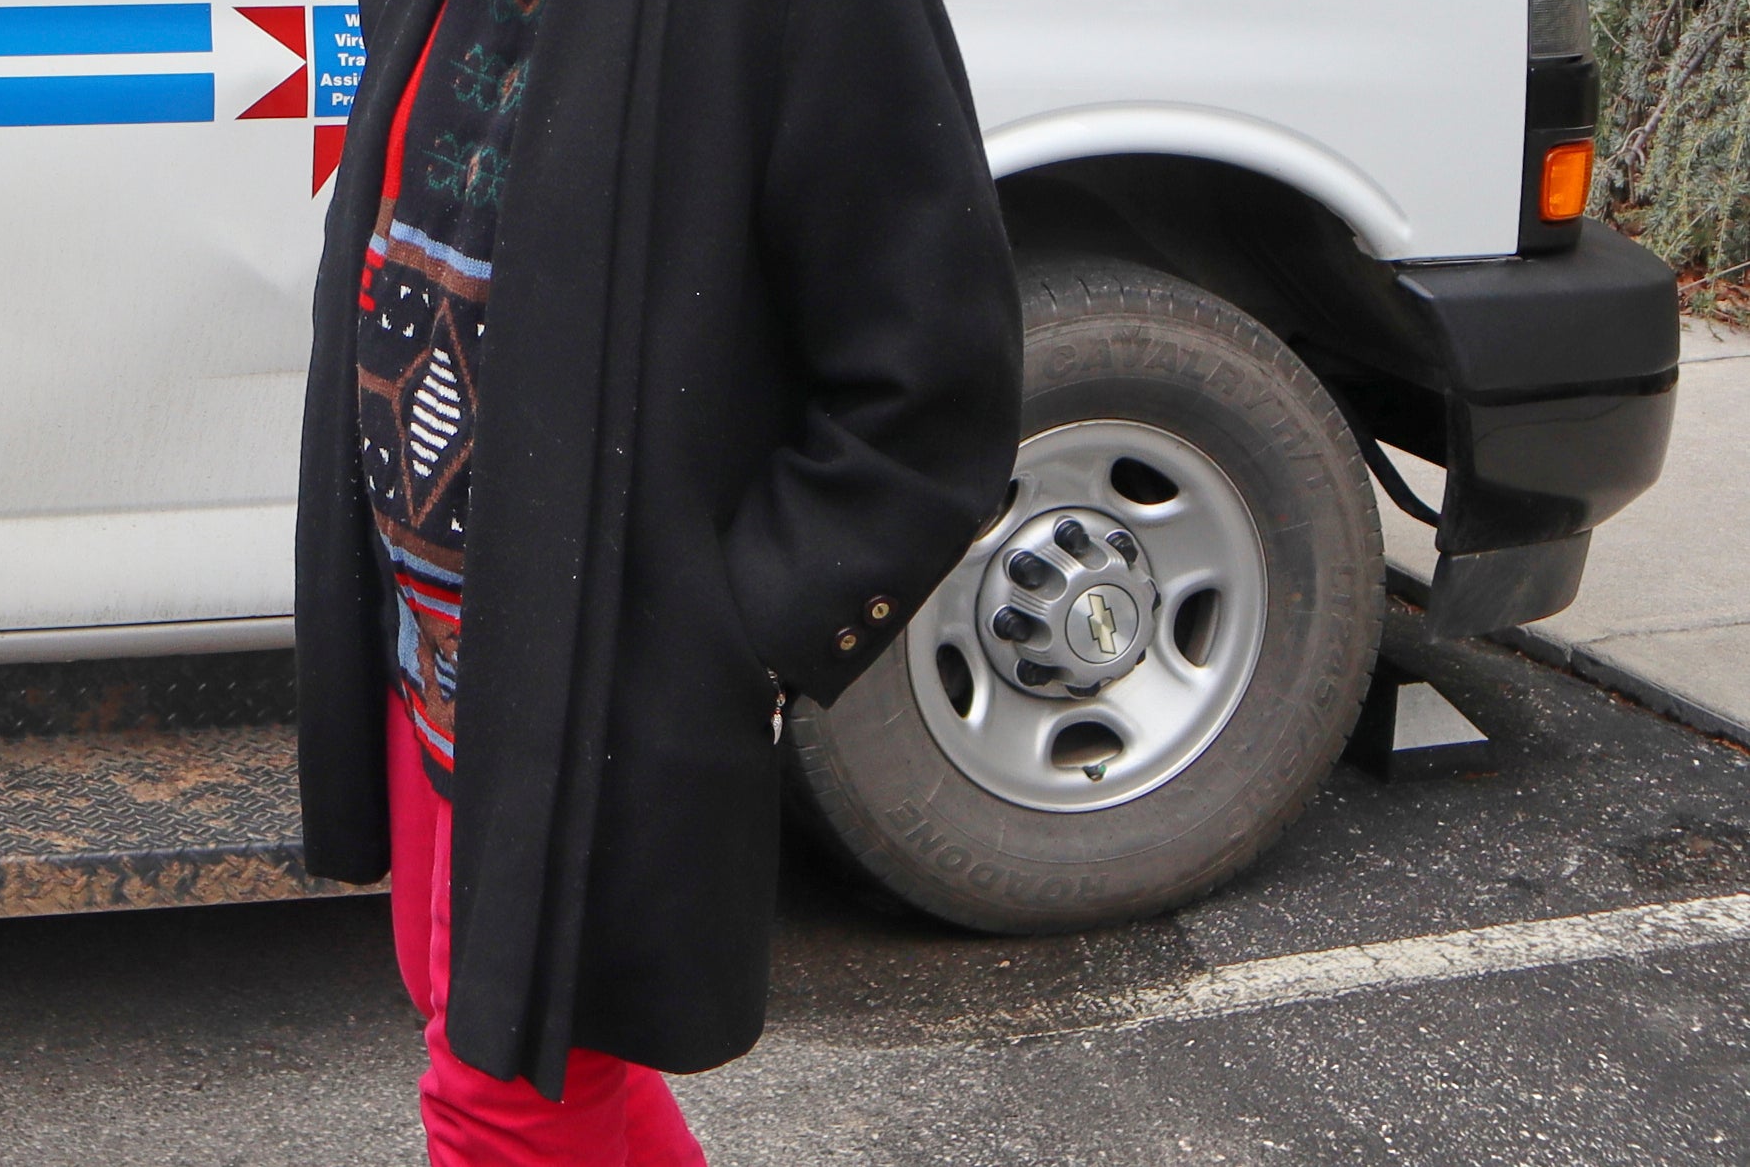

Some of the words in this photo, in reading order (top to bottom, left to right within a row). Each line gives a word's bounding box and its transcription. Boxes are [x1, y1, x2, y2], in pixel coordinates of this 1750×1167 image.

[345, 14, 360, 27] W
[338, 53, 366, 66] Tra
[320, 73, 361, 86] Assi
